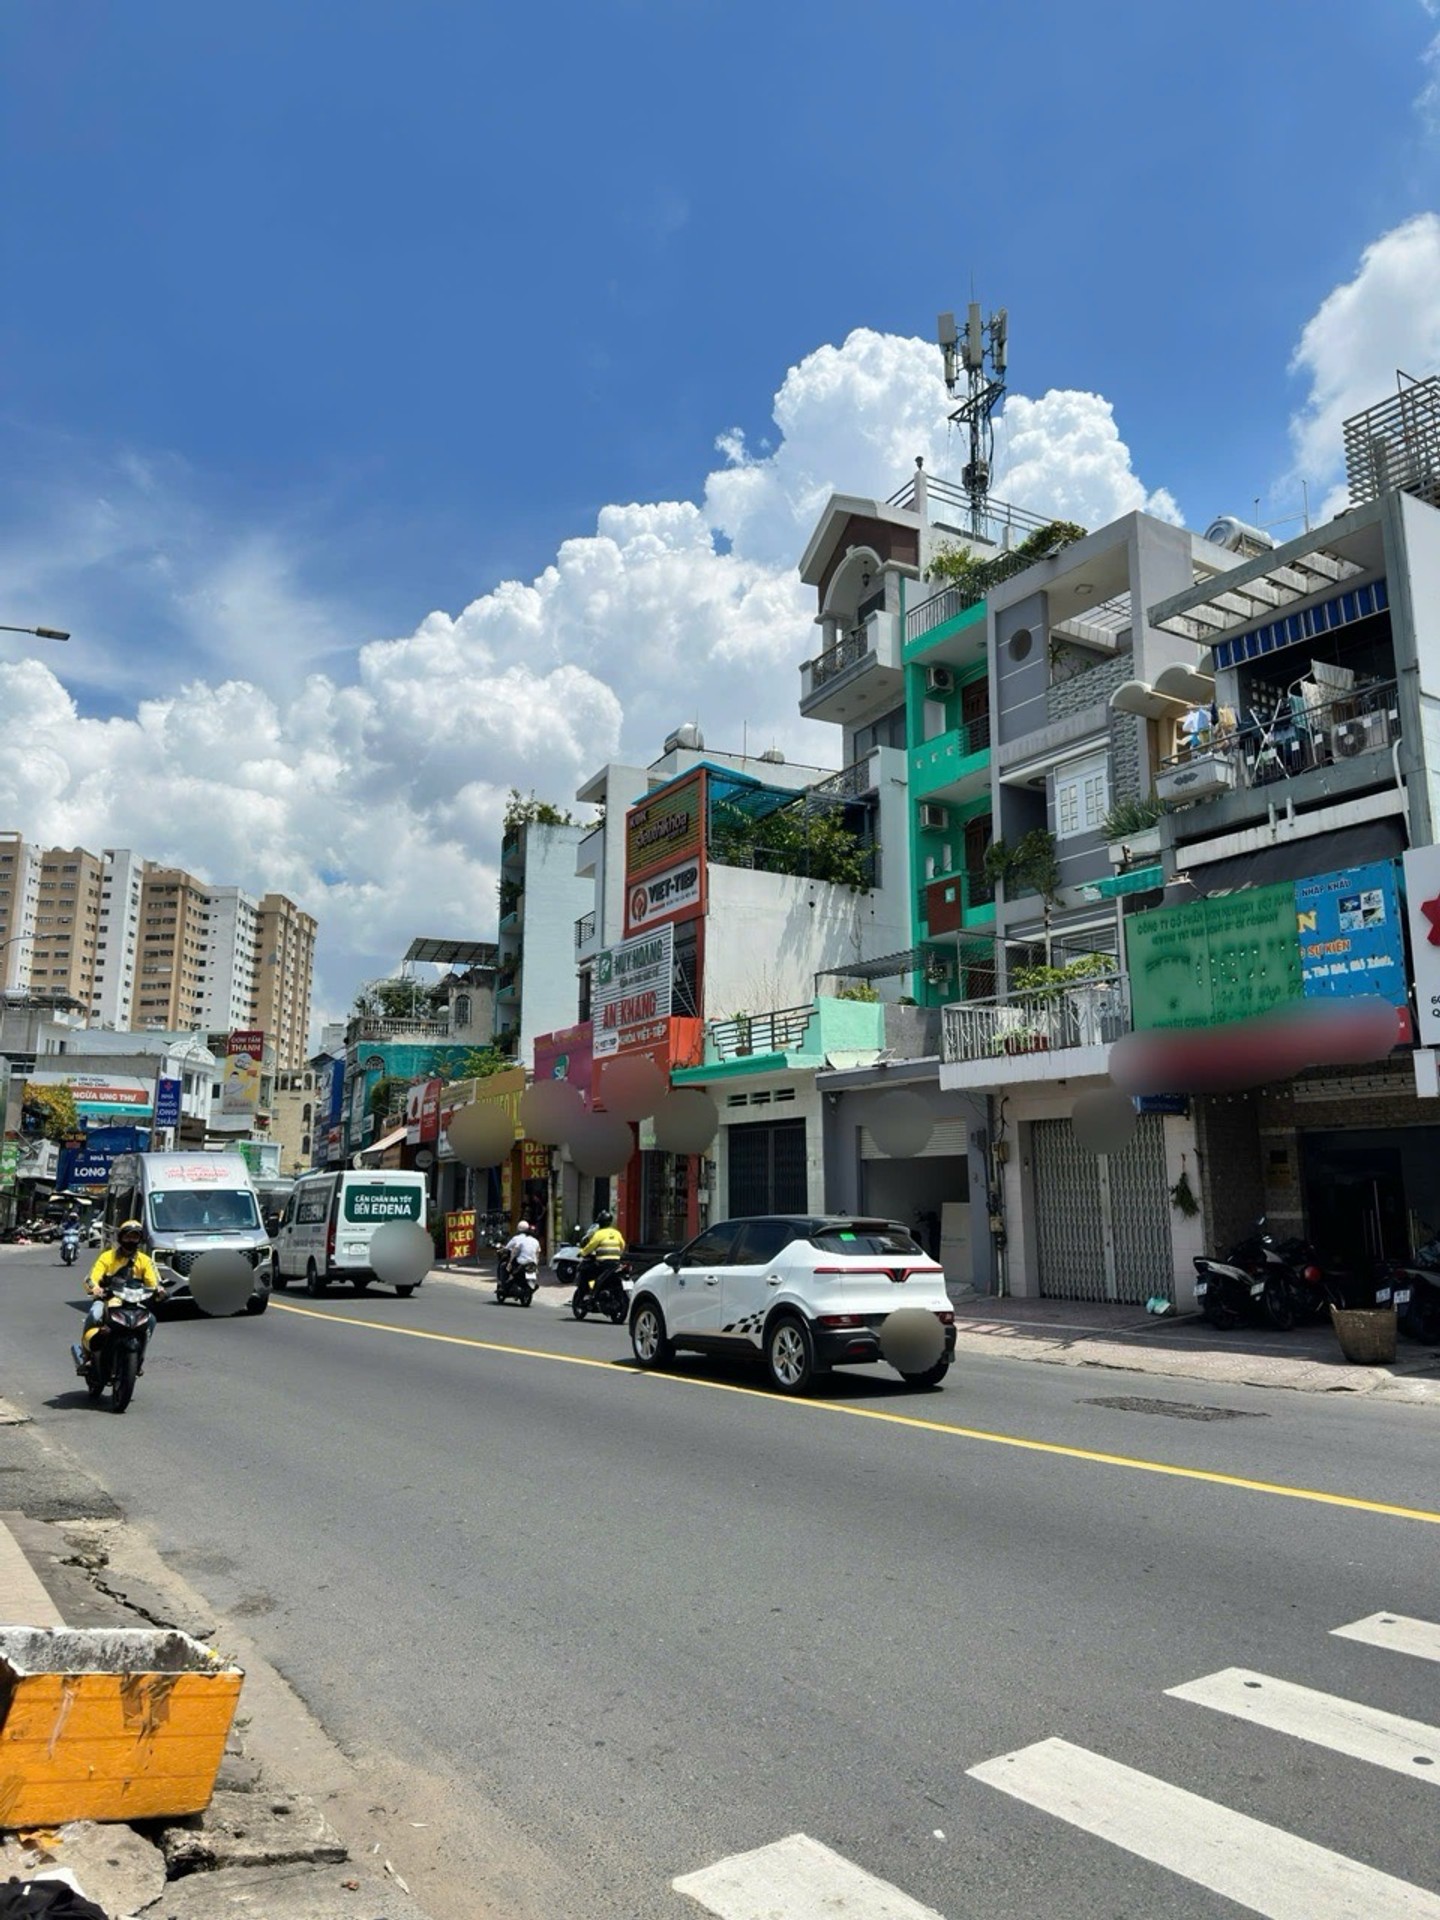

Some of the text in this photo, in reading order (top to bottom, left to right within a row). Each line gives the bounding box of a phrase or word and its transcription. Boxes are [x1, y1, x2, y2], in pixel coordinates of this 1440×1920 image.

[74, 1167, 106, 1178] LONG
[371, 1203, 411, 1215] EDENA
[449, 1229, 474, 1243] KEO
[453, 1245, 470, 1258] XE
